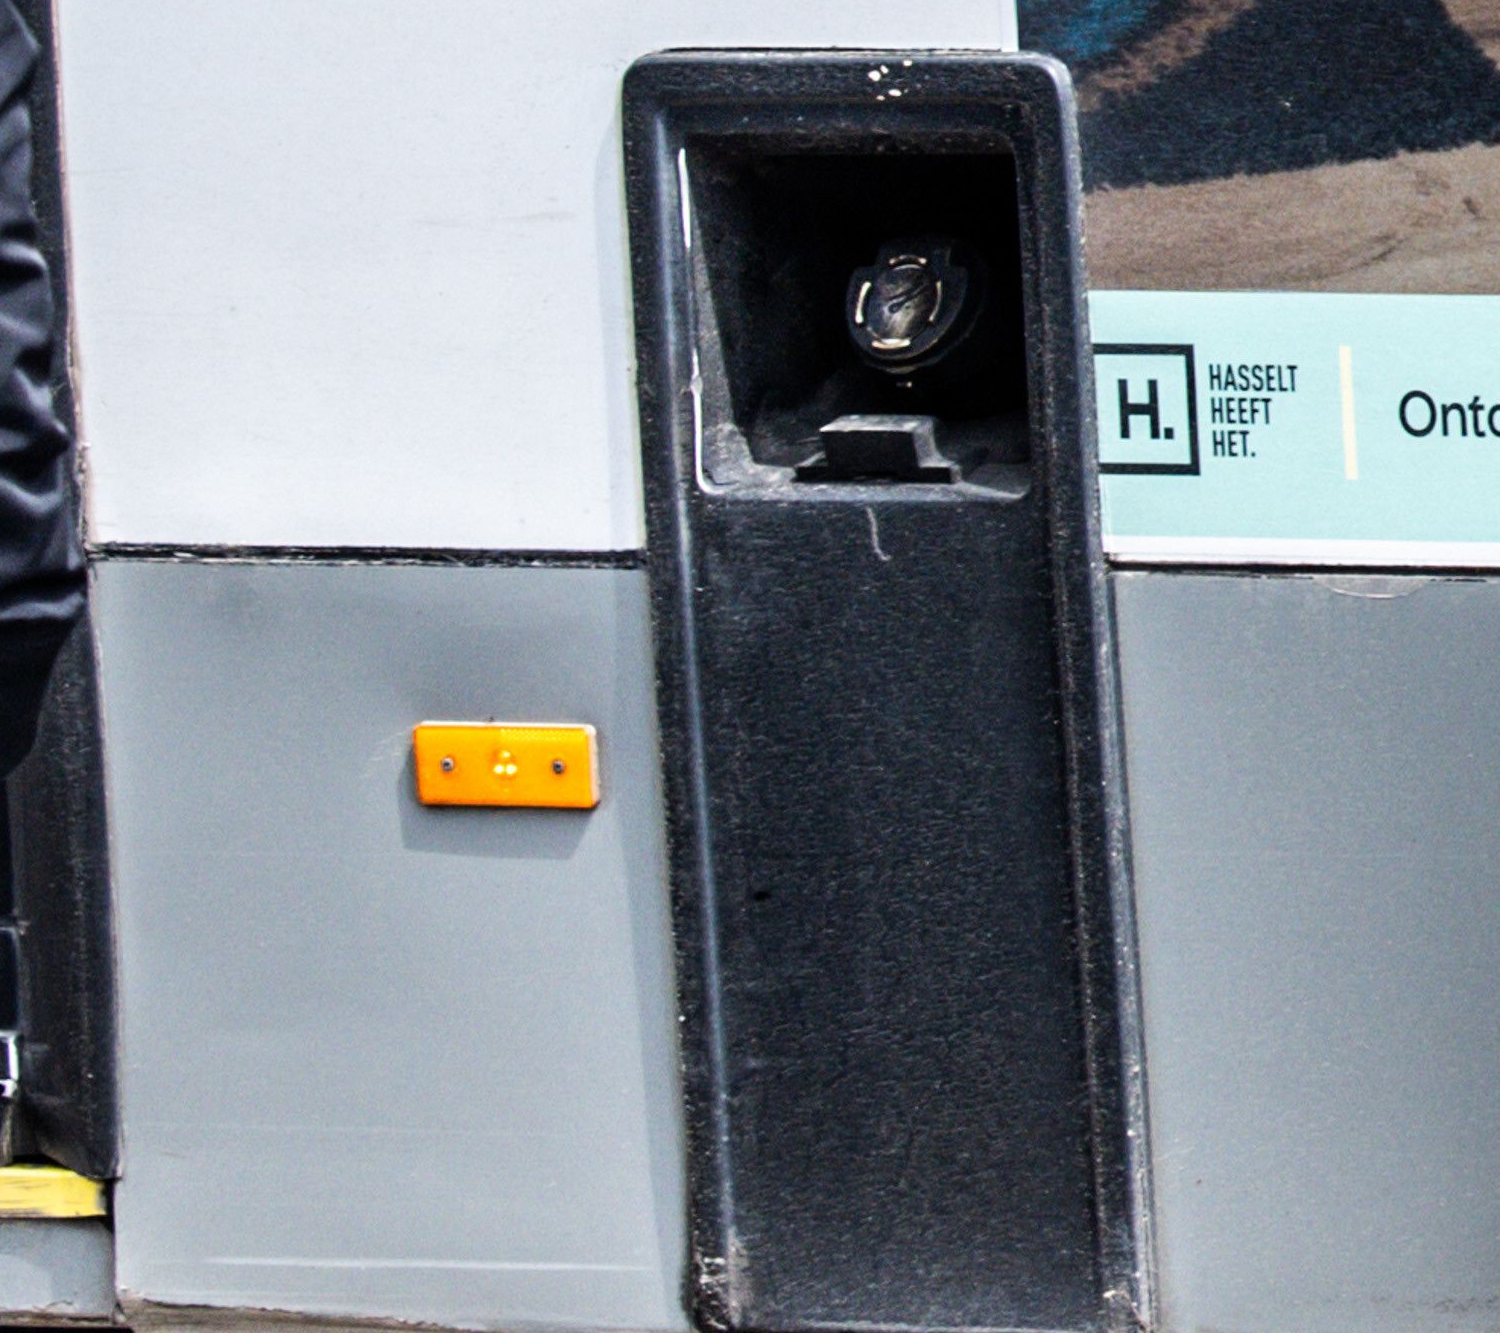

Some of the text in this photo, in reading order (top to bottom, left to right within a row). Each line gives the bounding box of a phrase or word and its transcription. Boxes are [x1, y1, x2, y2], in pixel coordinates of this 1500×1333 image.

[1208, 364, 1298, 392] HASSELT
[1117, 379, 1175, 440] H.
[1210, 397, 1272, 424] HEEFT
[1212, 430, 1257, 457] HET.
